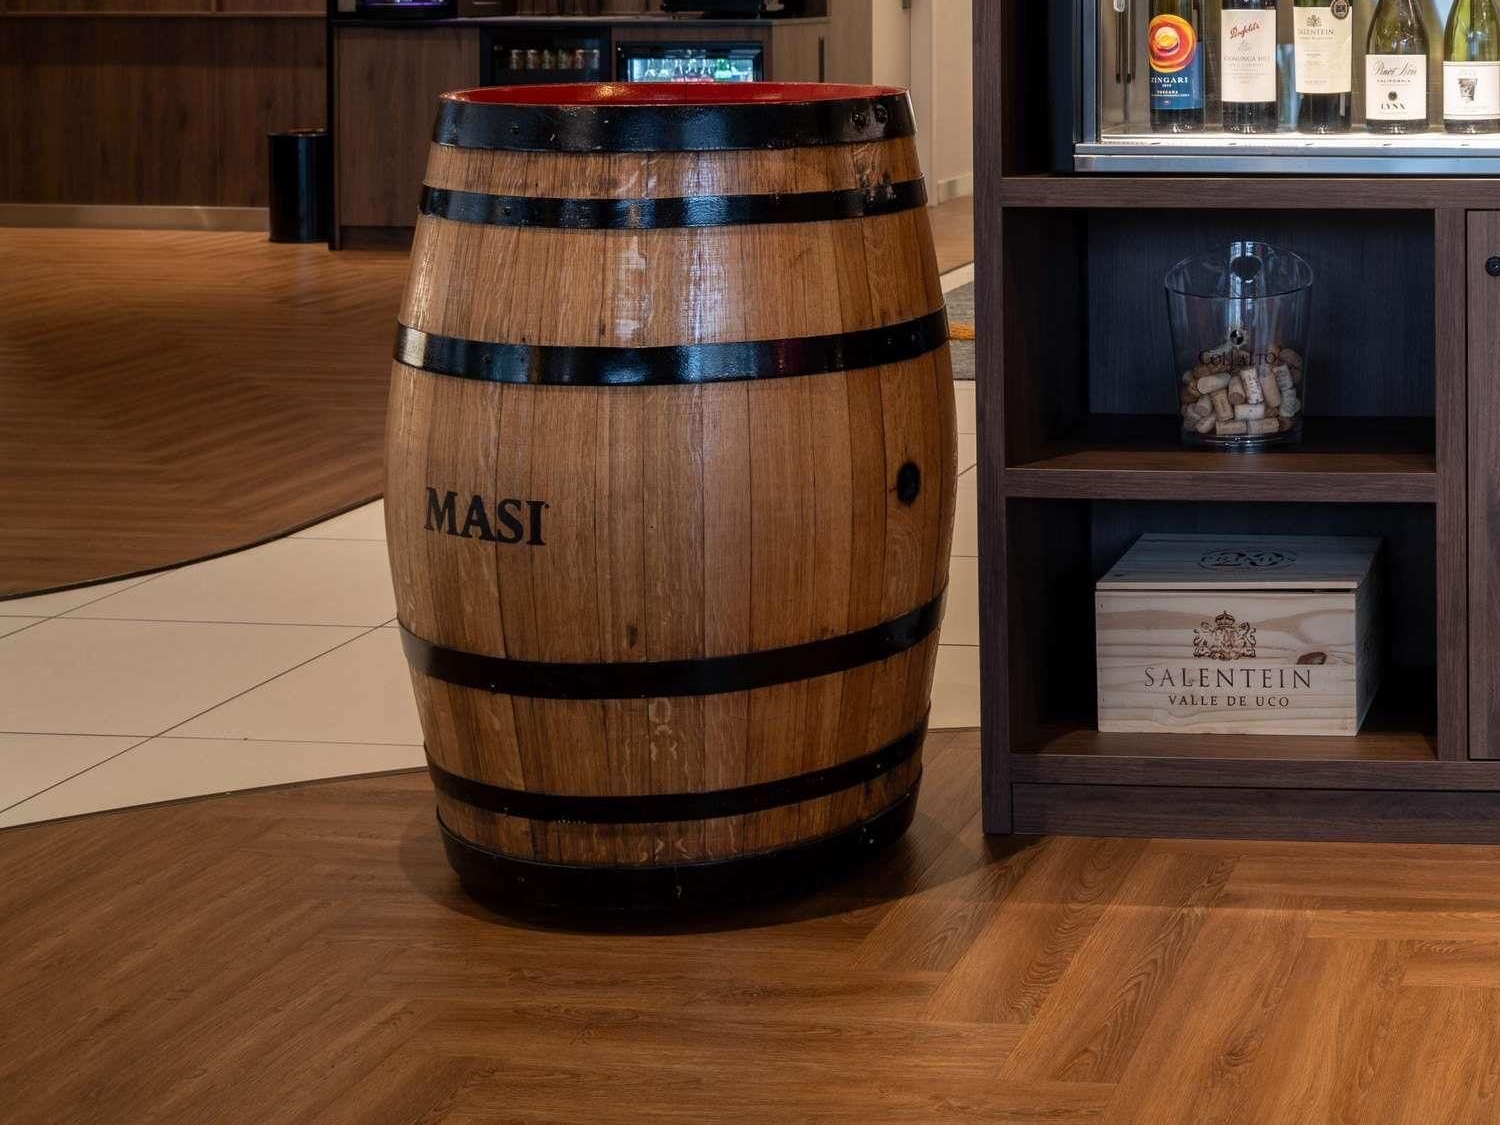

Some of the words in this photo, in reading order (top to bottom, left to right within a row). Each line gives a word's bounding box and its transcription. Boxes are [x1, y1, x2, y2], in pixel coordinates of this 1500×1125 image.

[423, 486, 548, 547] MASI
[1143, 667, 1312, 690] SALENTEIN
[1168, 694, 1218, 707] VALLE
[1226, 695, 1247, 707] DE
[1255, 696, 1290, 708] UCO
